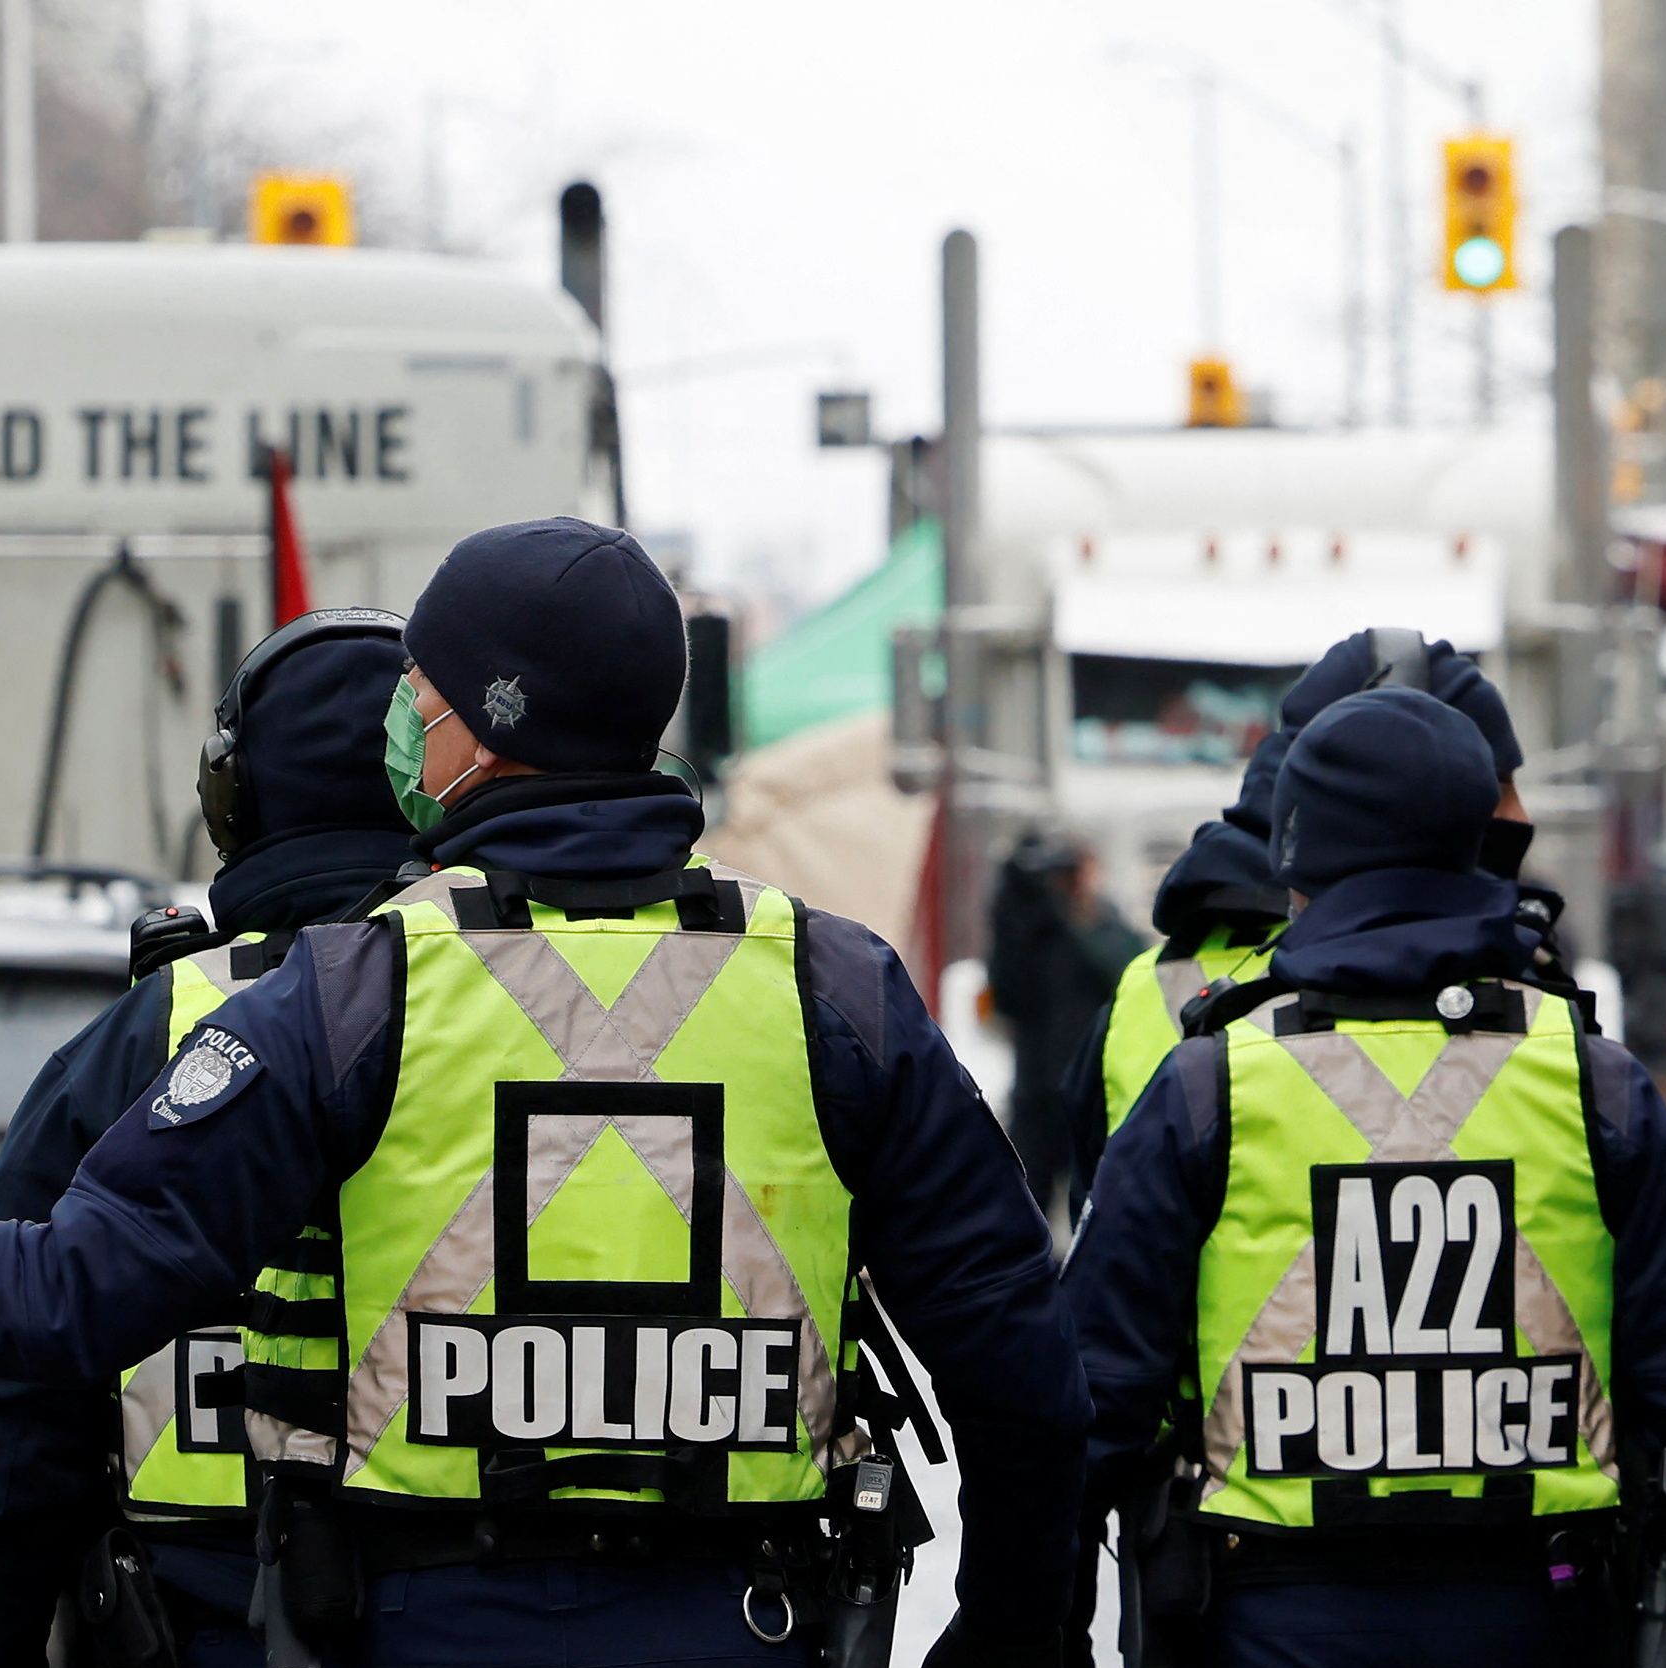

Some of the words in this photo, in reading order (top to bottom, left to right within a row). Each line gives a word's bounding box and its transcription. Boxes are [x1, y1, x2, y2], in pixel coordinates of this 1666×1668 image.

[77, 408, 211, 482] THE
[247, 408, 411, 482] LINE
[199, 1027, 256, 1071] POLICE
[1325, 1174, 1503, 1355] A22
[419, 1325, 792, 1442] POLICE
[1251, 1366, 1572, 1471] POLICE
